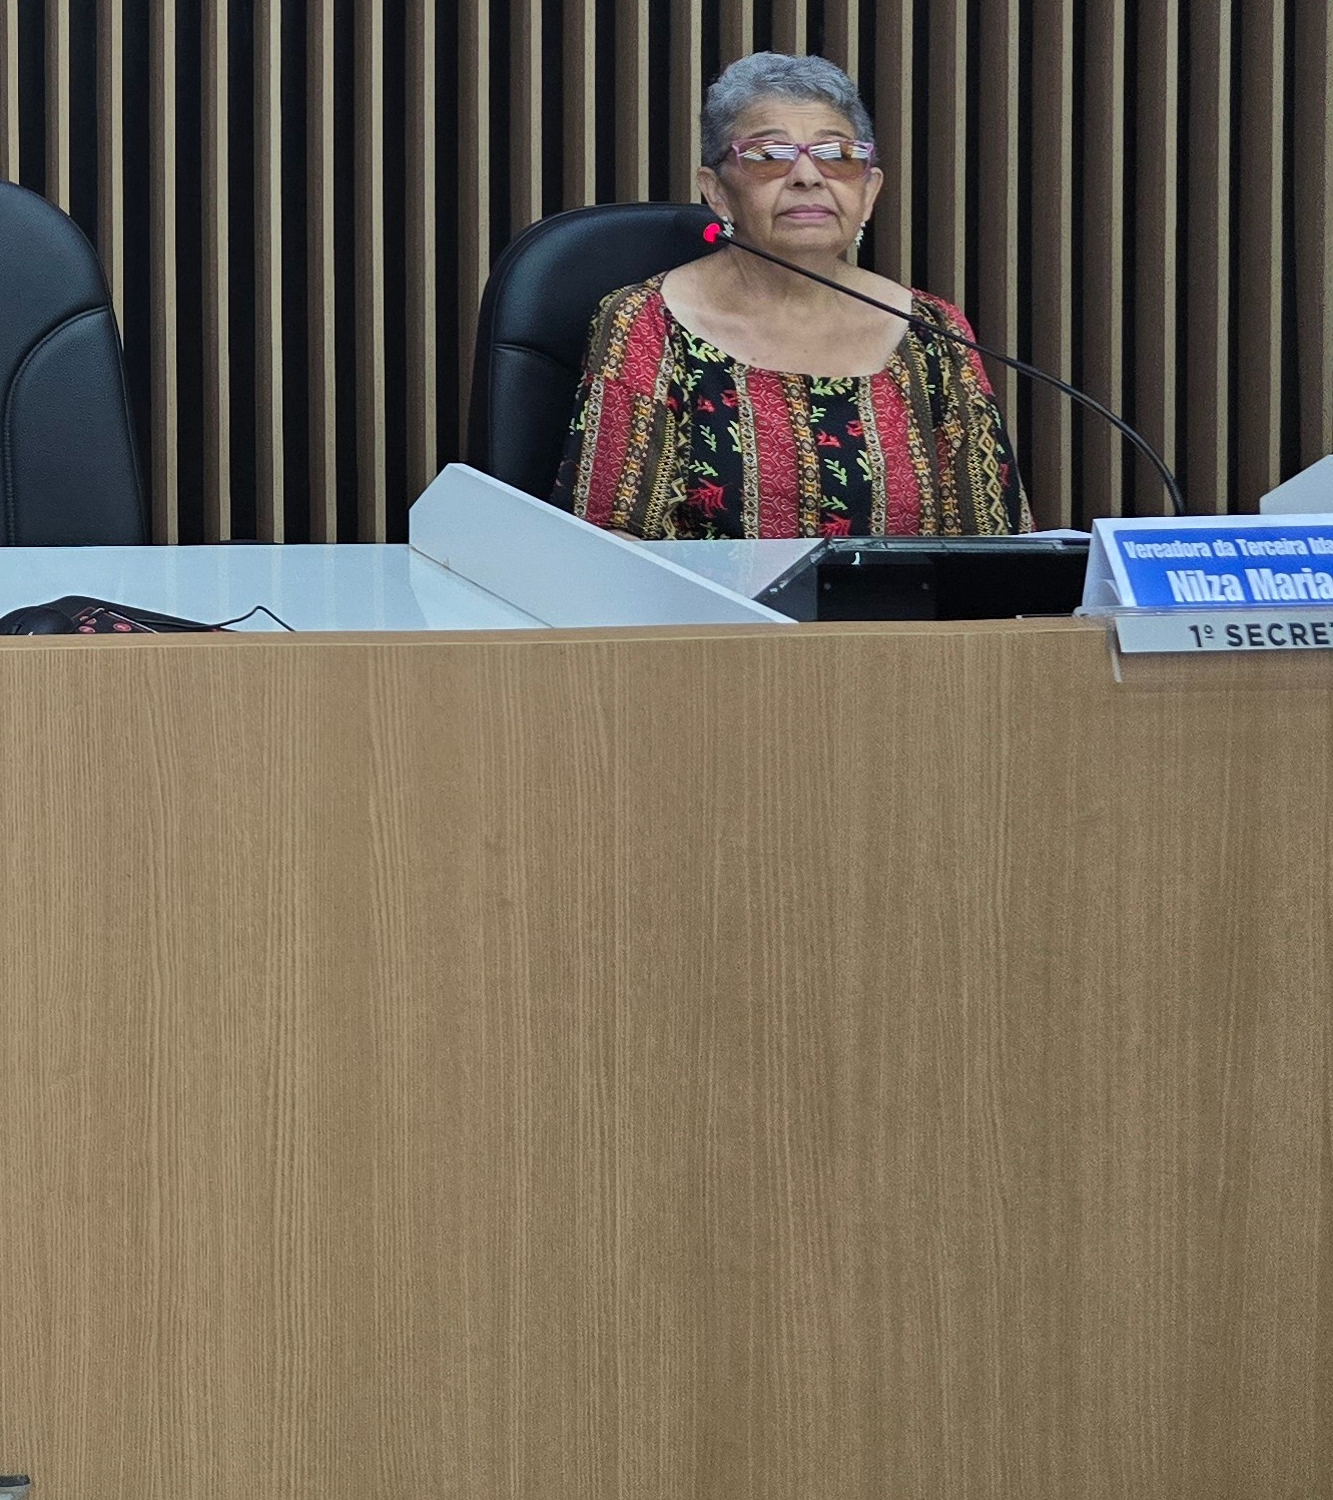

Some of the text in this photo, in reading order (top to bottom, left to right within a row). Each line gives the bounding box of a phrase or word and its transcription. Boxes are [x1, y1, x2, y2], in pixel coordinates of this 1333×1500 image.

[1124, 539, 1212, 559] Vereadora
[1213, 539, 1238, 557] da
[1235, 537, 1309, 556] Terceira
[1166, 567, 1333, 602] Nilza Maria
[1225, 621, 1333, 647] SECRE
